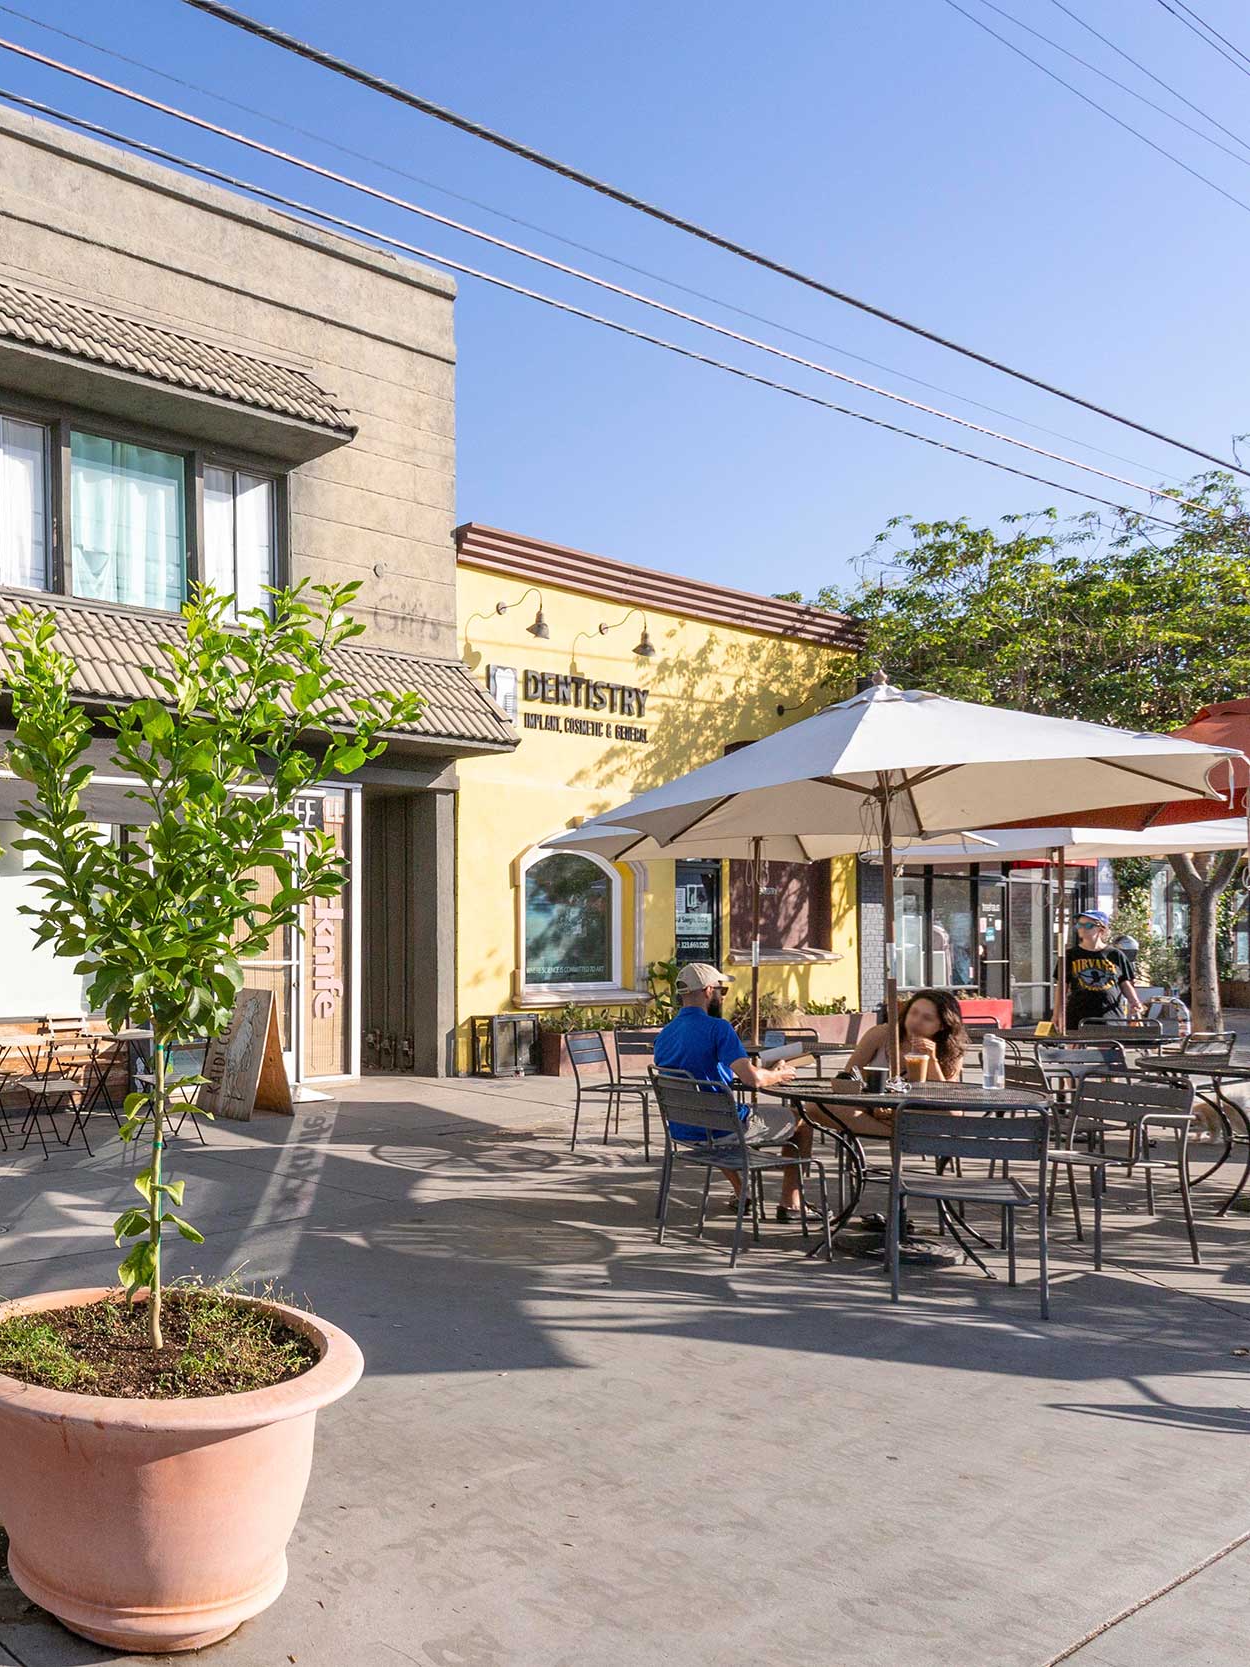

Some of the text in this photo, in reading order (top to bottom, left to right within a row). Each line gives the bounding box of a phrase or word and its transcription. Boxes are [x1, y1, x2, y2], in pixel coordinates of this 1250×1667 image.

[523, 669, 650, 719] DENTISTRY
[523, 712, 649, 744] IMPLANT, COSMETIC & GENERAL
[206, 1050, 226, 1095] KALDI
